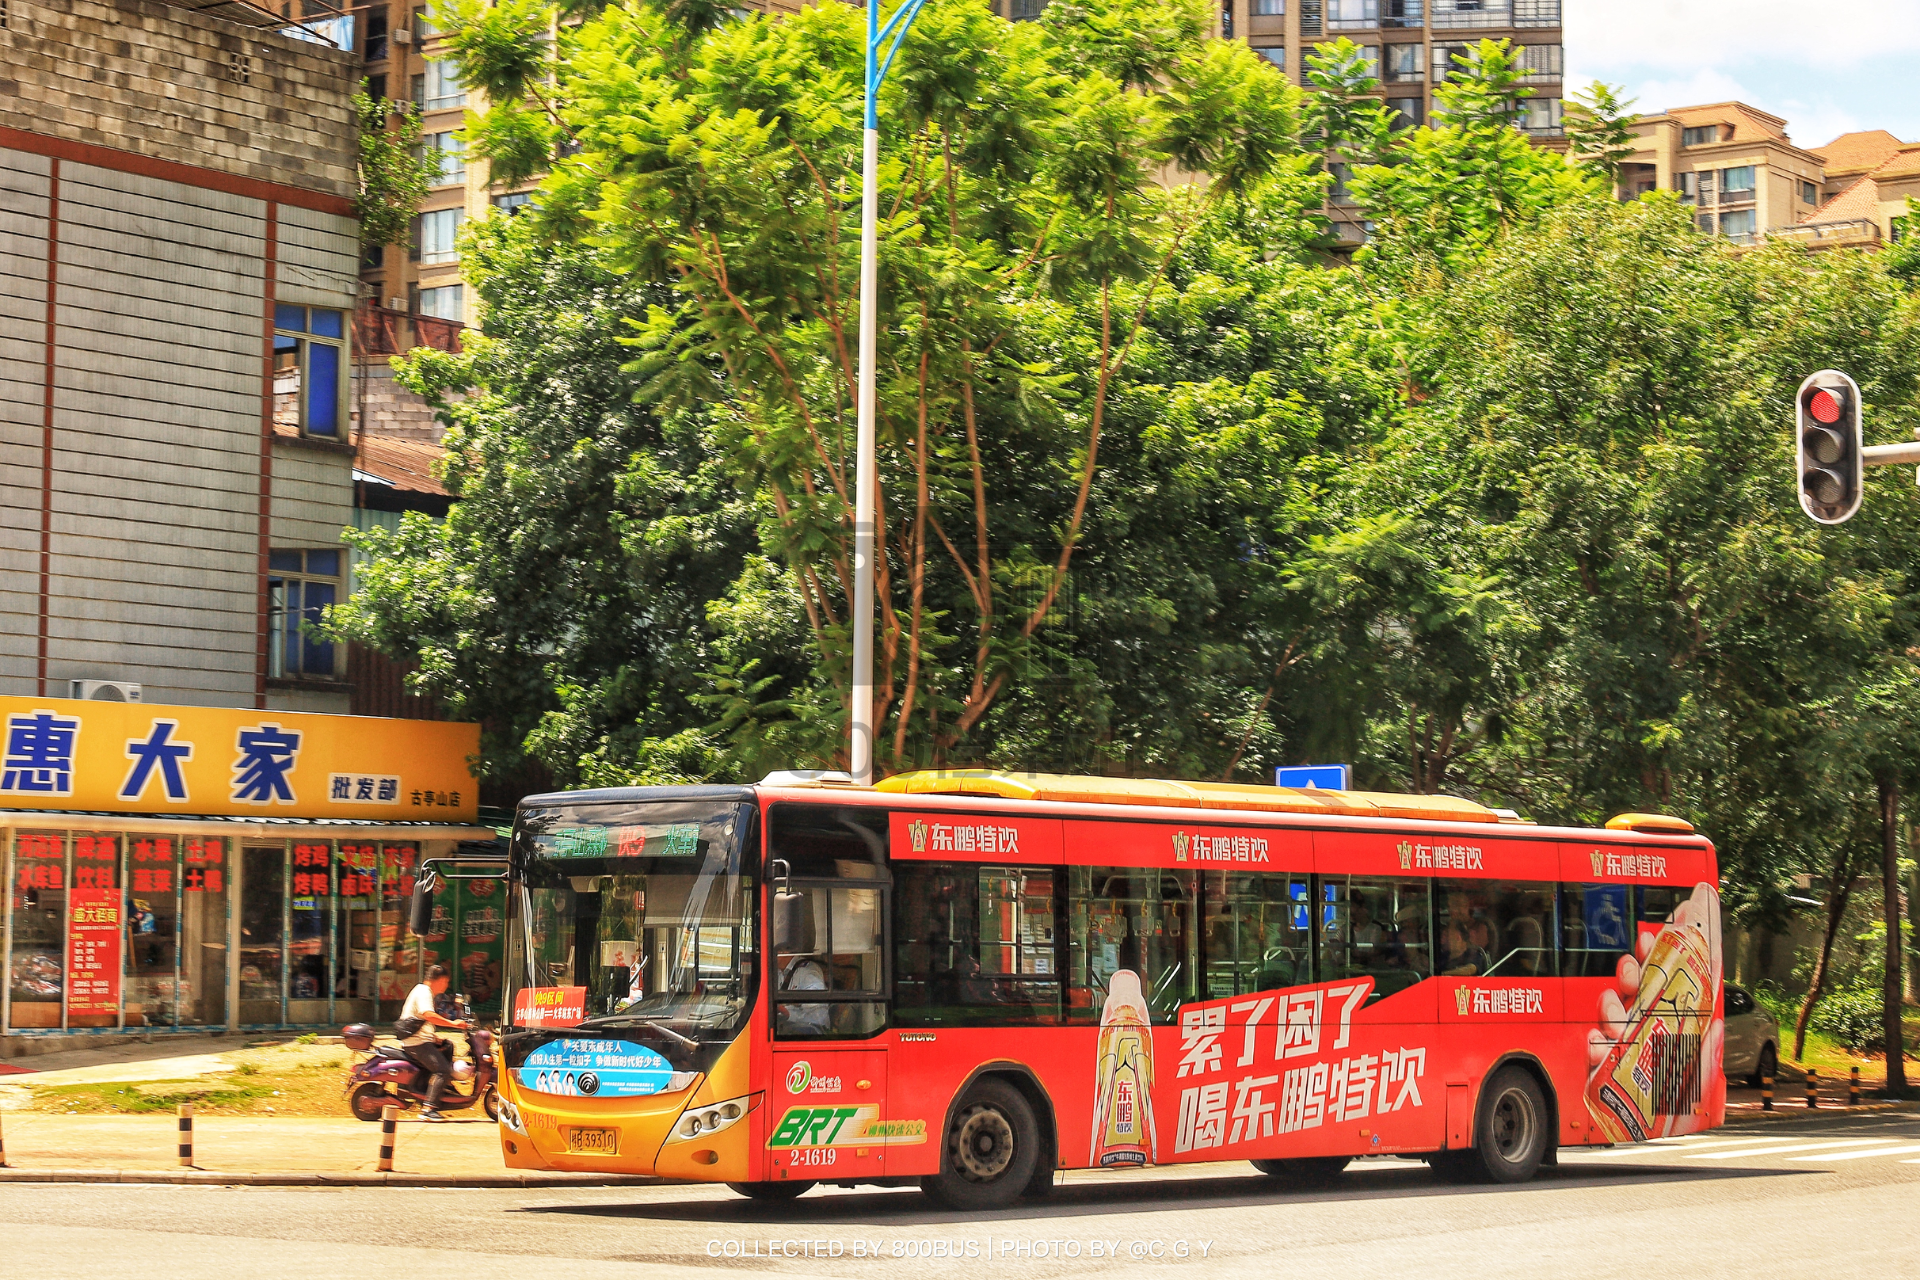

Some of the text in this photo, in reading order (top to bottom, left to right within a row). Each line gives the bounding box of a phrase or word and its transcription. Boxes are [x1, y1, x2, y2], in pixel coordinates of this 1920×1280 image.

[0, 711, 462, 808] 惠大家 批发部 古亭山店
[76, 836, 115, 860] 啤酒
[134, 838, 172, 861] 水果
[931, 823, 1019, 854] 东鹏特饮
[1192, 834, 1270, 863] 东鹏特饮
[186, 840, 222, 863] 土鸡
[294, 844, 328, 867] 烤鸡
[1414, 844, 1483, 870] 东鹏特饮
[18, 865, 63, 889] 水库鱼
[76, 866, 114, 888] 饮料
[1606, 853, 1667, 878] 东鹏特饮
[134, 869, 172, 892] 蔬菜
[185, 869, 222, 892] 土鸭
[294, 872, 328, 895] 烤鸭
[341, 873, 375, 895] 卤味
[73, 907, 118, 923] 盛大招商
[535, 991, 564, 1005] 快9区间
[1472, 987, 1544, 1013] 东鹏特饮
[899, 1032, 937, 1042] YUTONG
[1176, 983, 1370, 1079] 累了困了
[571, 1041, 623, 1053] 关爱未成年人
[530, 1054, 662, 1068] 扣好人生第一粒扣子 争做新时代好少年
[1116, 1081, 1133, 1122] 东鹏
[1174, 1046, 1426, 1154] 喝东鹏特饮
[522, 1112, 558, 1130] 2-1619
[768, 1108, 859, 1147] BRT
[1116, 1122, 1133, 1133] 特饮
[790, 1148, 837, 1167] 2-1619
